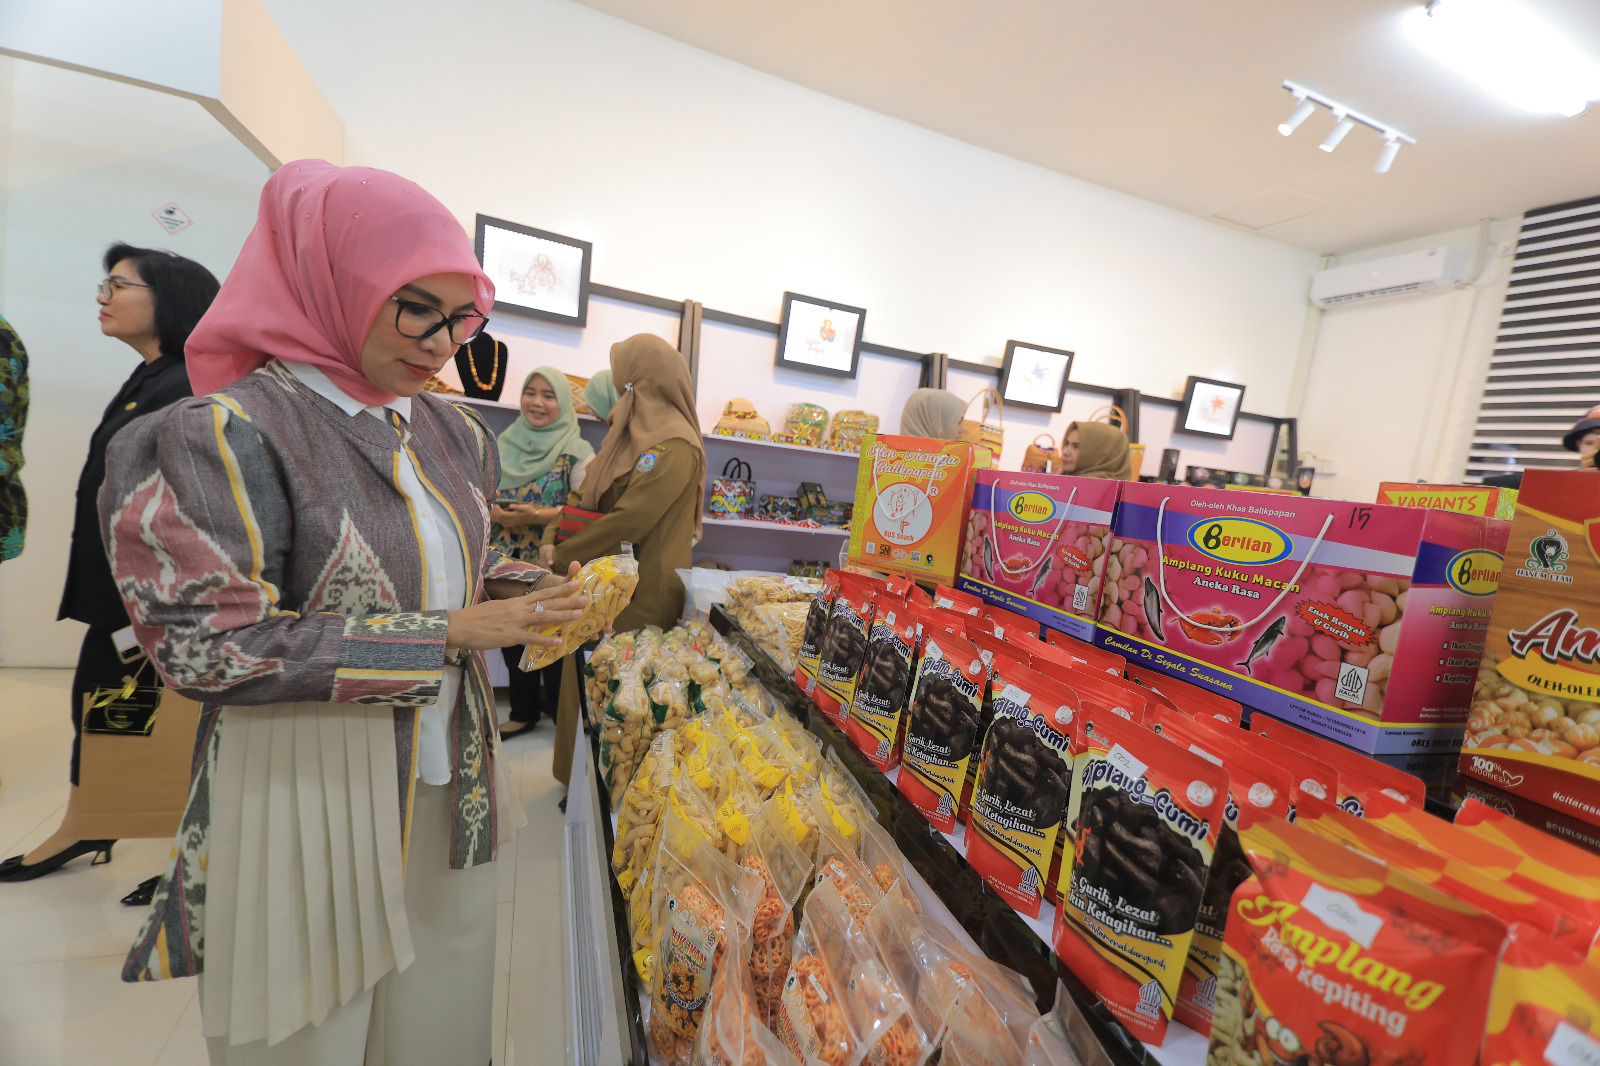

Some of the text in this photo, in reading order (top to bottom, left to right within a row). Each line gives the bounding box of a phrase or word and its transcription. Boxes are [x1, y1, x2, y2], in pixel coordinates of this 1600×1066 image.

[876, 459, 946, 481] Balikpapan
[1014, 496, 1048, 515] Berlian
[1190, 500, 1296, 518] Oleh-oleh Khas Balikpapan
[1349, 507, 1372, 530] 15
[1398, 495, 1478, 512] VARIANTS
[1203, 524, 1272, 554] Berlian
[1163, 556, 1300, 594] Amplang Kuku Macan
[1193, 576, 1260, 599] Aneka Rasa
[1308, 606, 1366, 636] Enak Renyah
[1429, 605, 1466, 618] Amplang
[1468, 606, 1487, 617] Kuku
[1322, 622, 1350, 640] Gurih
[1104, 636, 1233, 691] Camilan Di Segala Suasana
[952, 668, 979, 698] Cumi
[1444, 674, 1470, 684] Kepiting
[1033, 715, 1070, 752] Cumi
[1470, 766, 1510, 786] INDONESIA
[1472, 756, 1502, 773] 100%
[982, 788, 1034, 818] Gurih, Lezat
[1154, 789, 1210, 841] Cumi
[985, 807, 1046, 839] Ketagihan...
[1080, 876, 1113, 909] Gurih,
[1116, 896, 1157, 923] Lezat
[1087, 900, 1172, 947] Ketagihan...
[1237, 896, 1445, 1011] Amplang
[1260, 926, 1298, 972] Rasa
